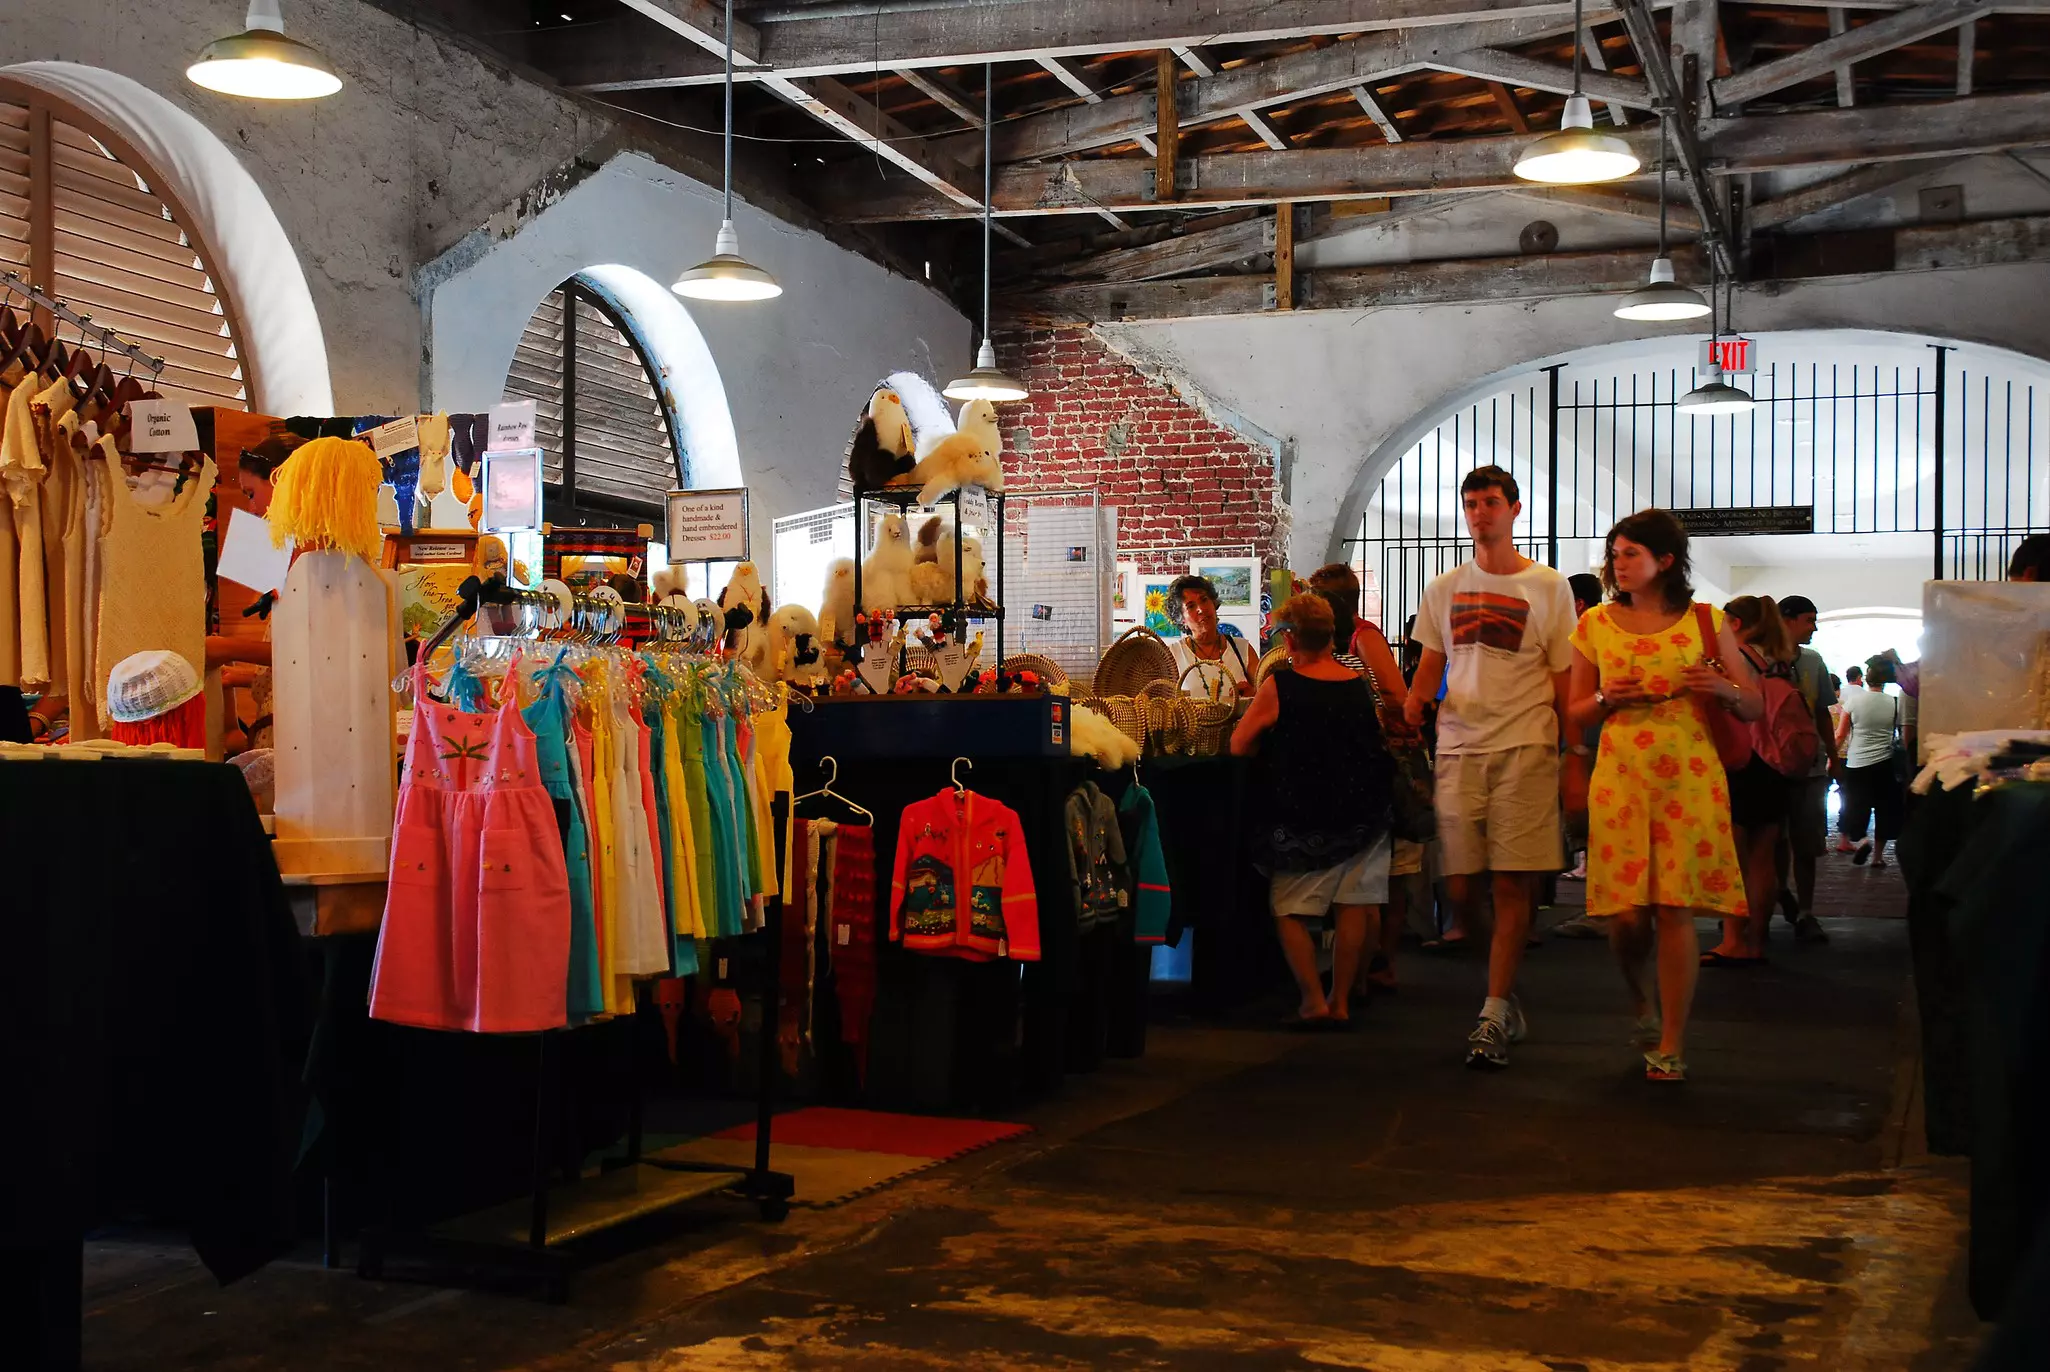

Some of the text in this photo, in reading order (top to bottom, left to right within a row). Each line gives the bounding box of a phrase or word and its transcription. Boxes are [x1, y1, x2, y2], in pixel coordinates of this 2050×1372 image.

[1709, 342, 1748, 370] EXIT
[147, 413, 171, 424] Organic
[149, 428, 171, 437] Cotton
[682, 505, 695, 513] One
[682, 514, 714, 522] handmade
[699, 523, 738, 531] embroidered
[682, 534, 706, 542] Dresses
[406, 572, 436, 591] How
[423, 586, 438, 597] the
[430, 593, 453, 604] Tree
